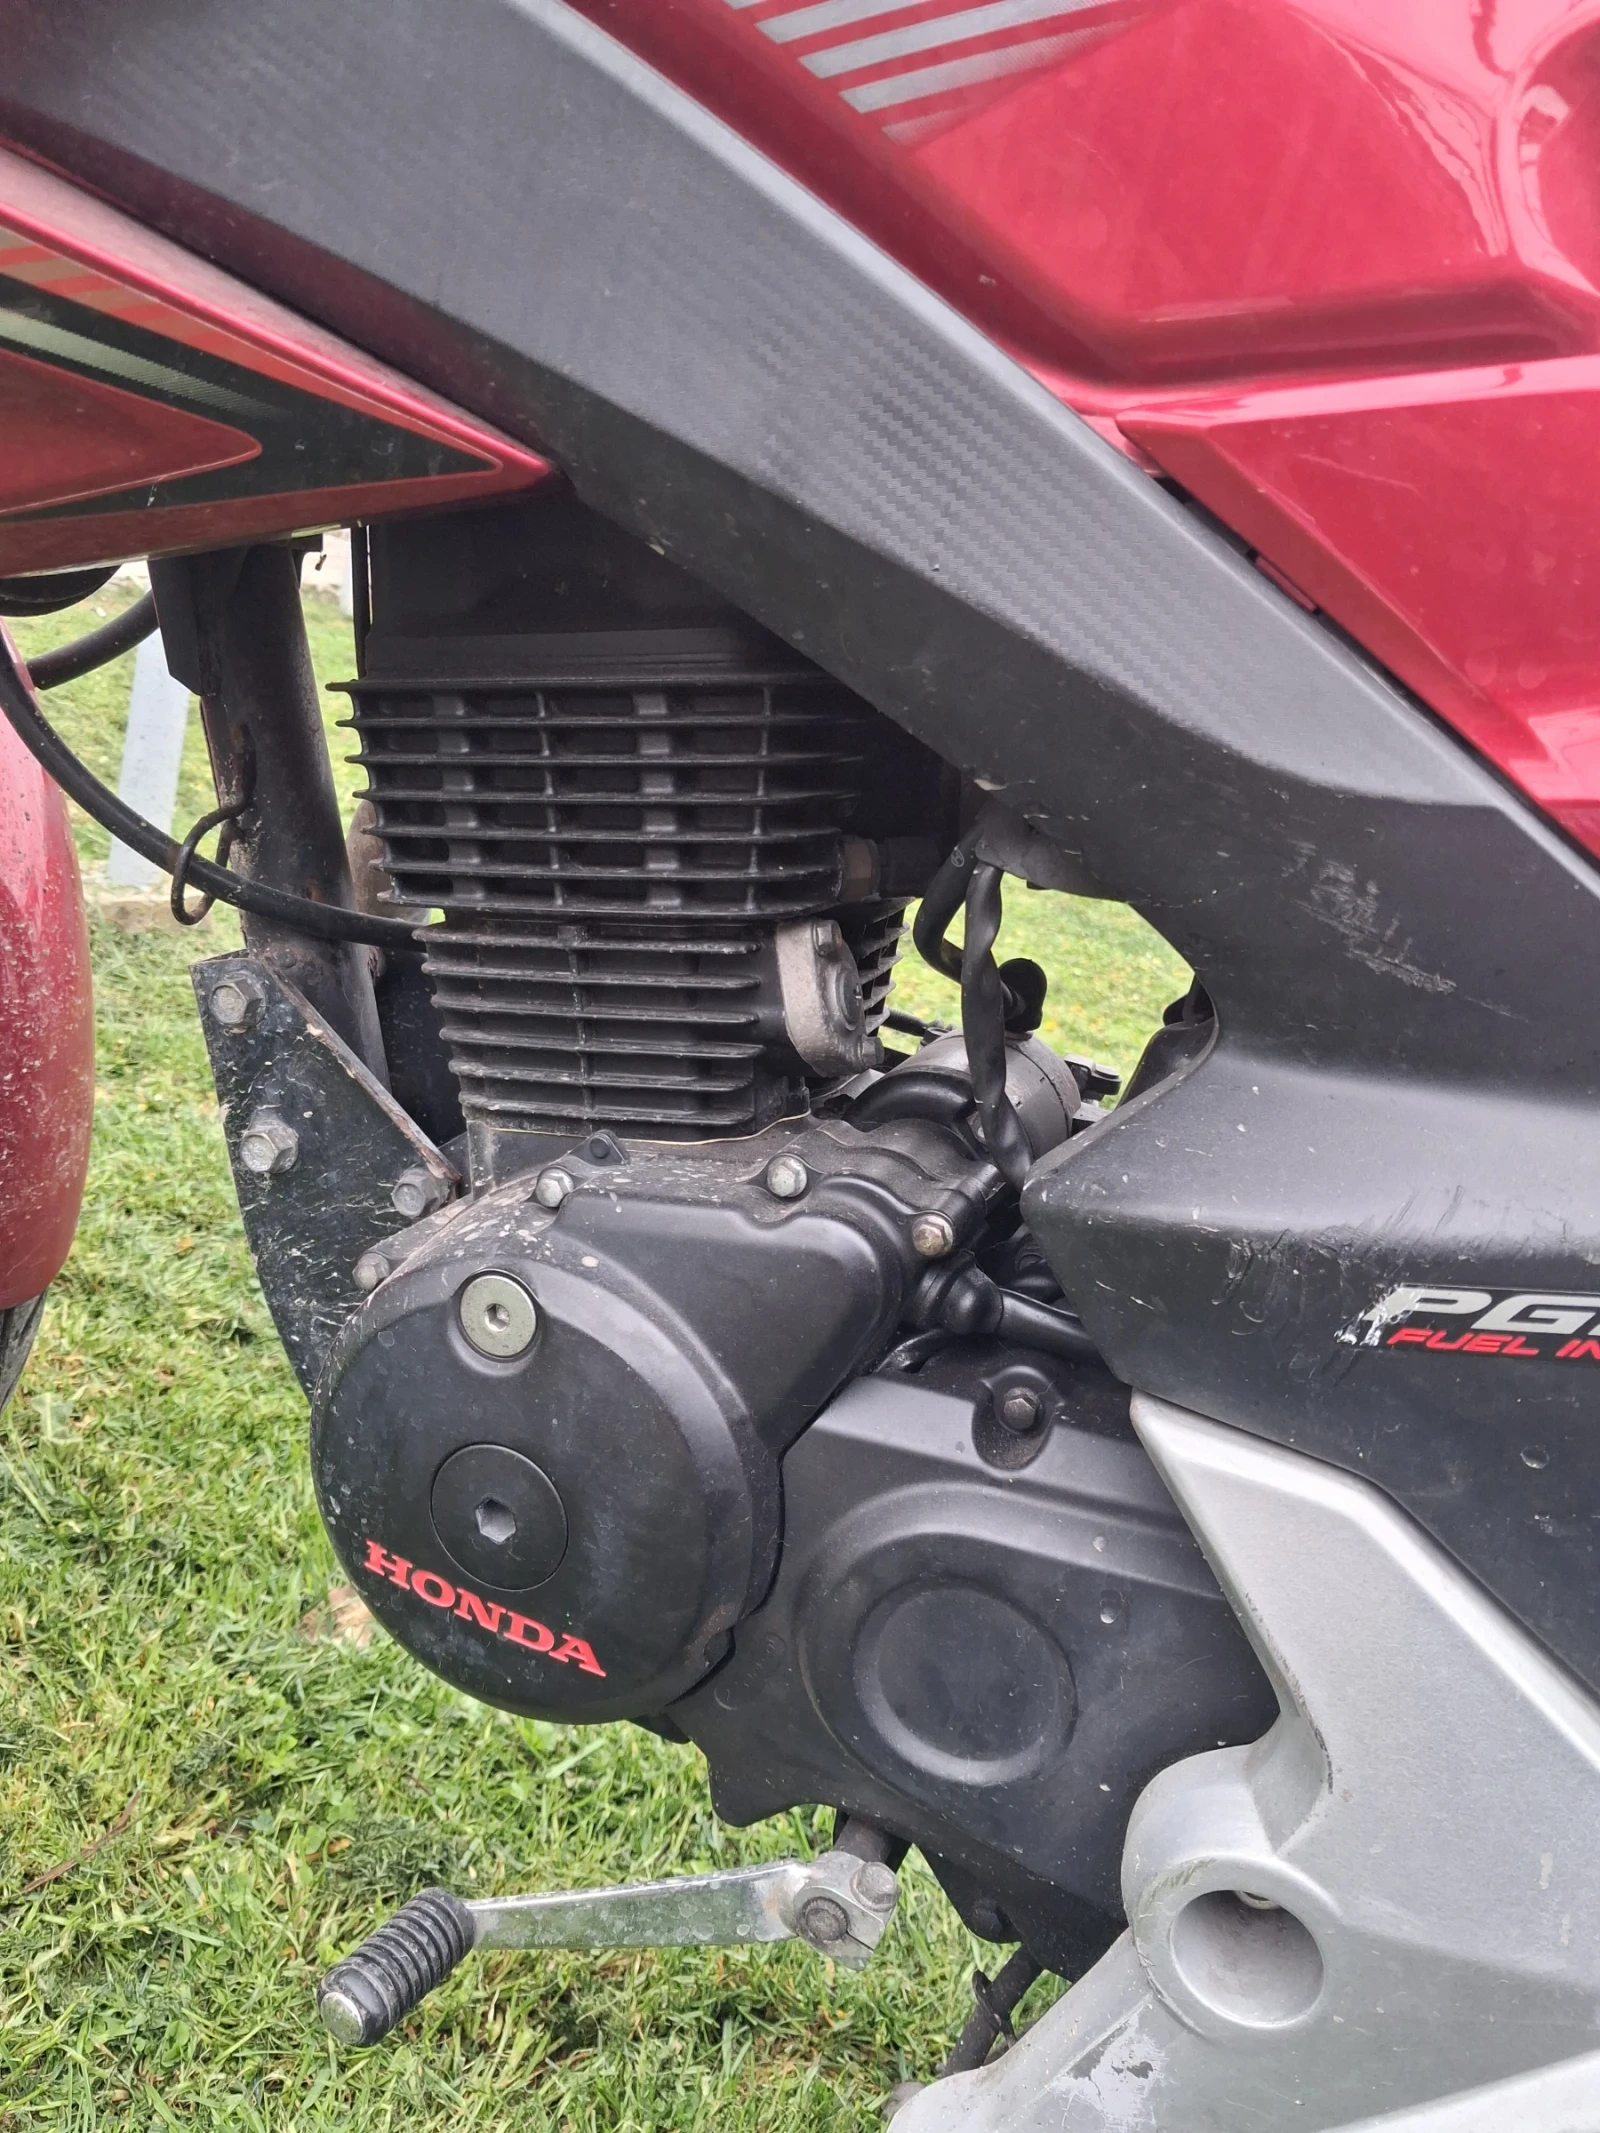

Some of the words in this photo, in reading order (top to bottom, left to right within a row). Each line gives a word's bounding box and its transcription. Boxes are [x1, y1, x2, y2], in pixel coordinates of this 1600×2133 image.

[1361, 1286, 1600, 1336] PG
[1386, 1327, 1539, 1356] FUEL
[364, 1538, 607, 1678] HONDA
